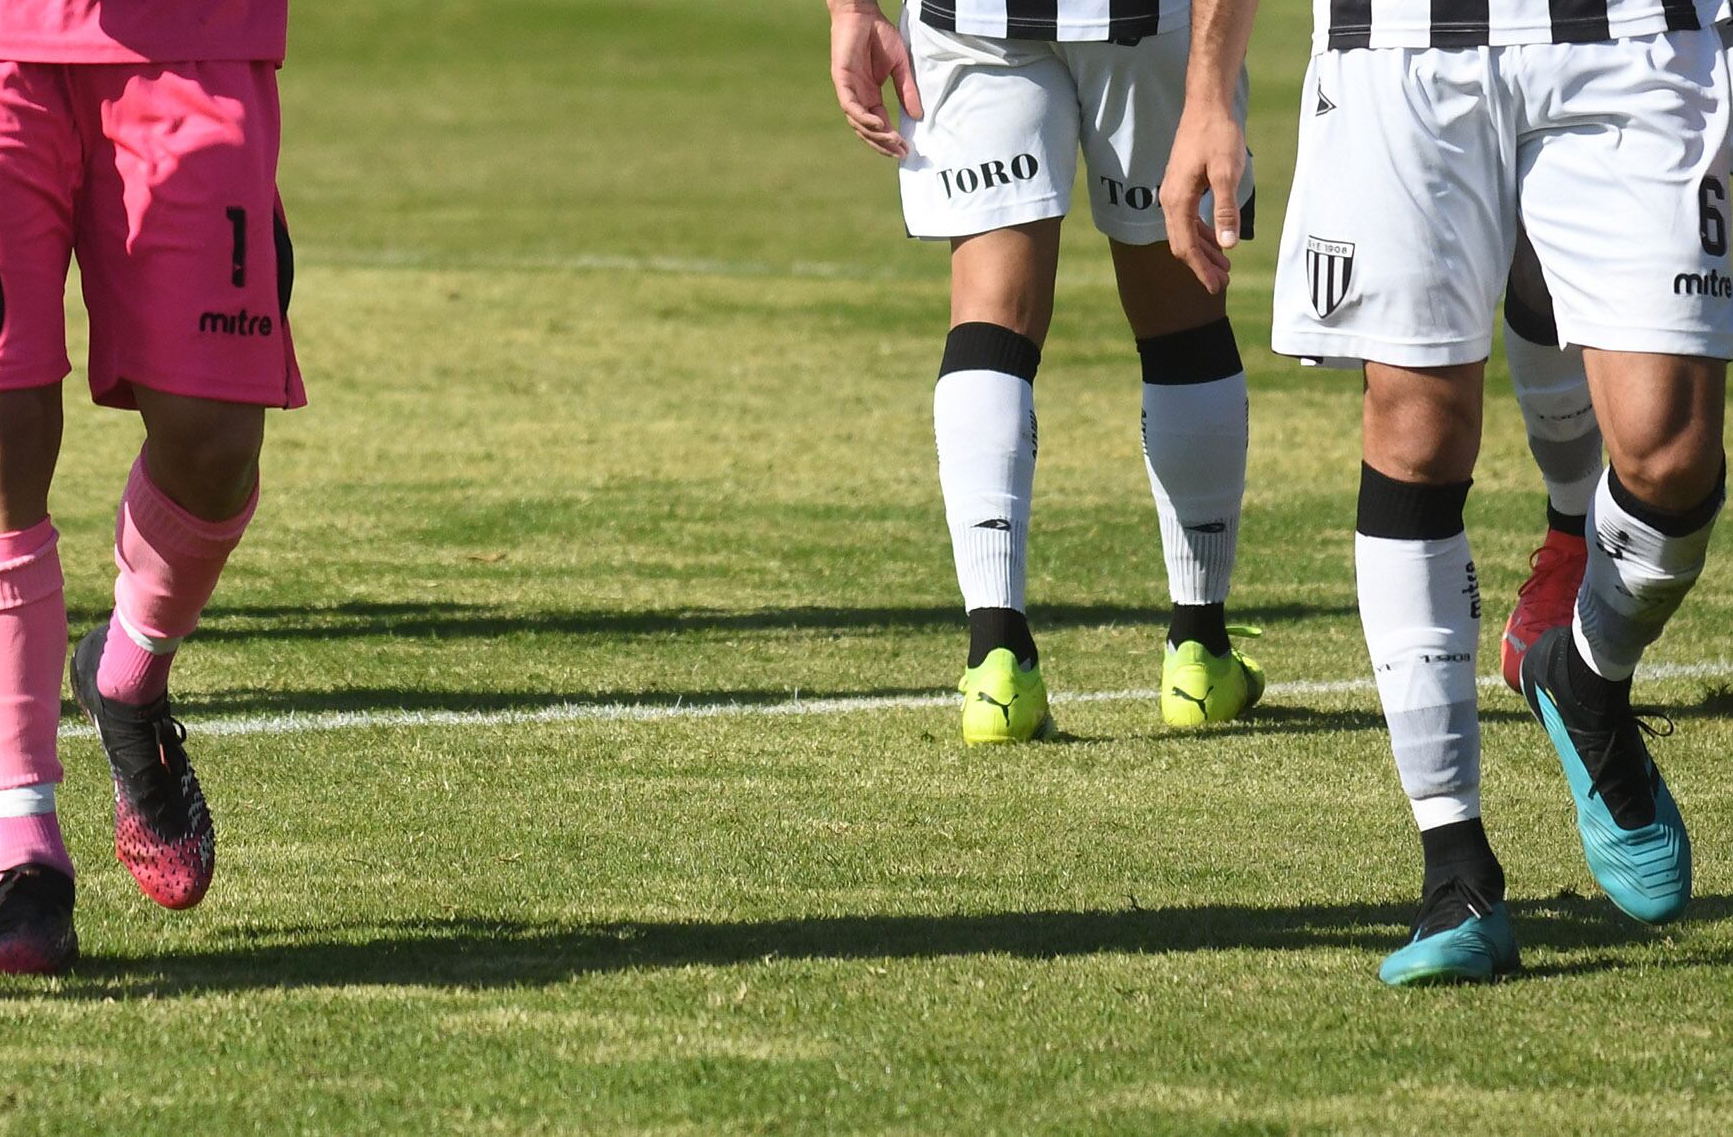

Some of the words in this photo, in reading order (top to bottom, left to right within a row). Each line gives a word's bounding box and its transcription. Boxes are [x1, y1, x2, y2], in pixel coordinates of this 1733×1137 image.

[937, 152, 1040, 200] TORO
[1100, 175, 1162, 211] TO
[1698, 174, 1727, 257] 6
[225, 206, 247, 289] 1
[1673, 267, 1733, 299] mitre
[199, 310, 273, 337] mitre
[1461, 560, 1481, 620] mitre
